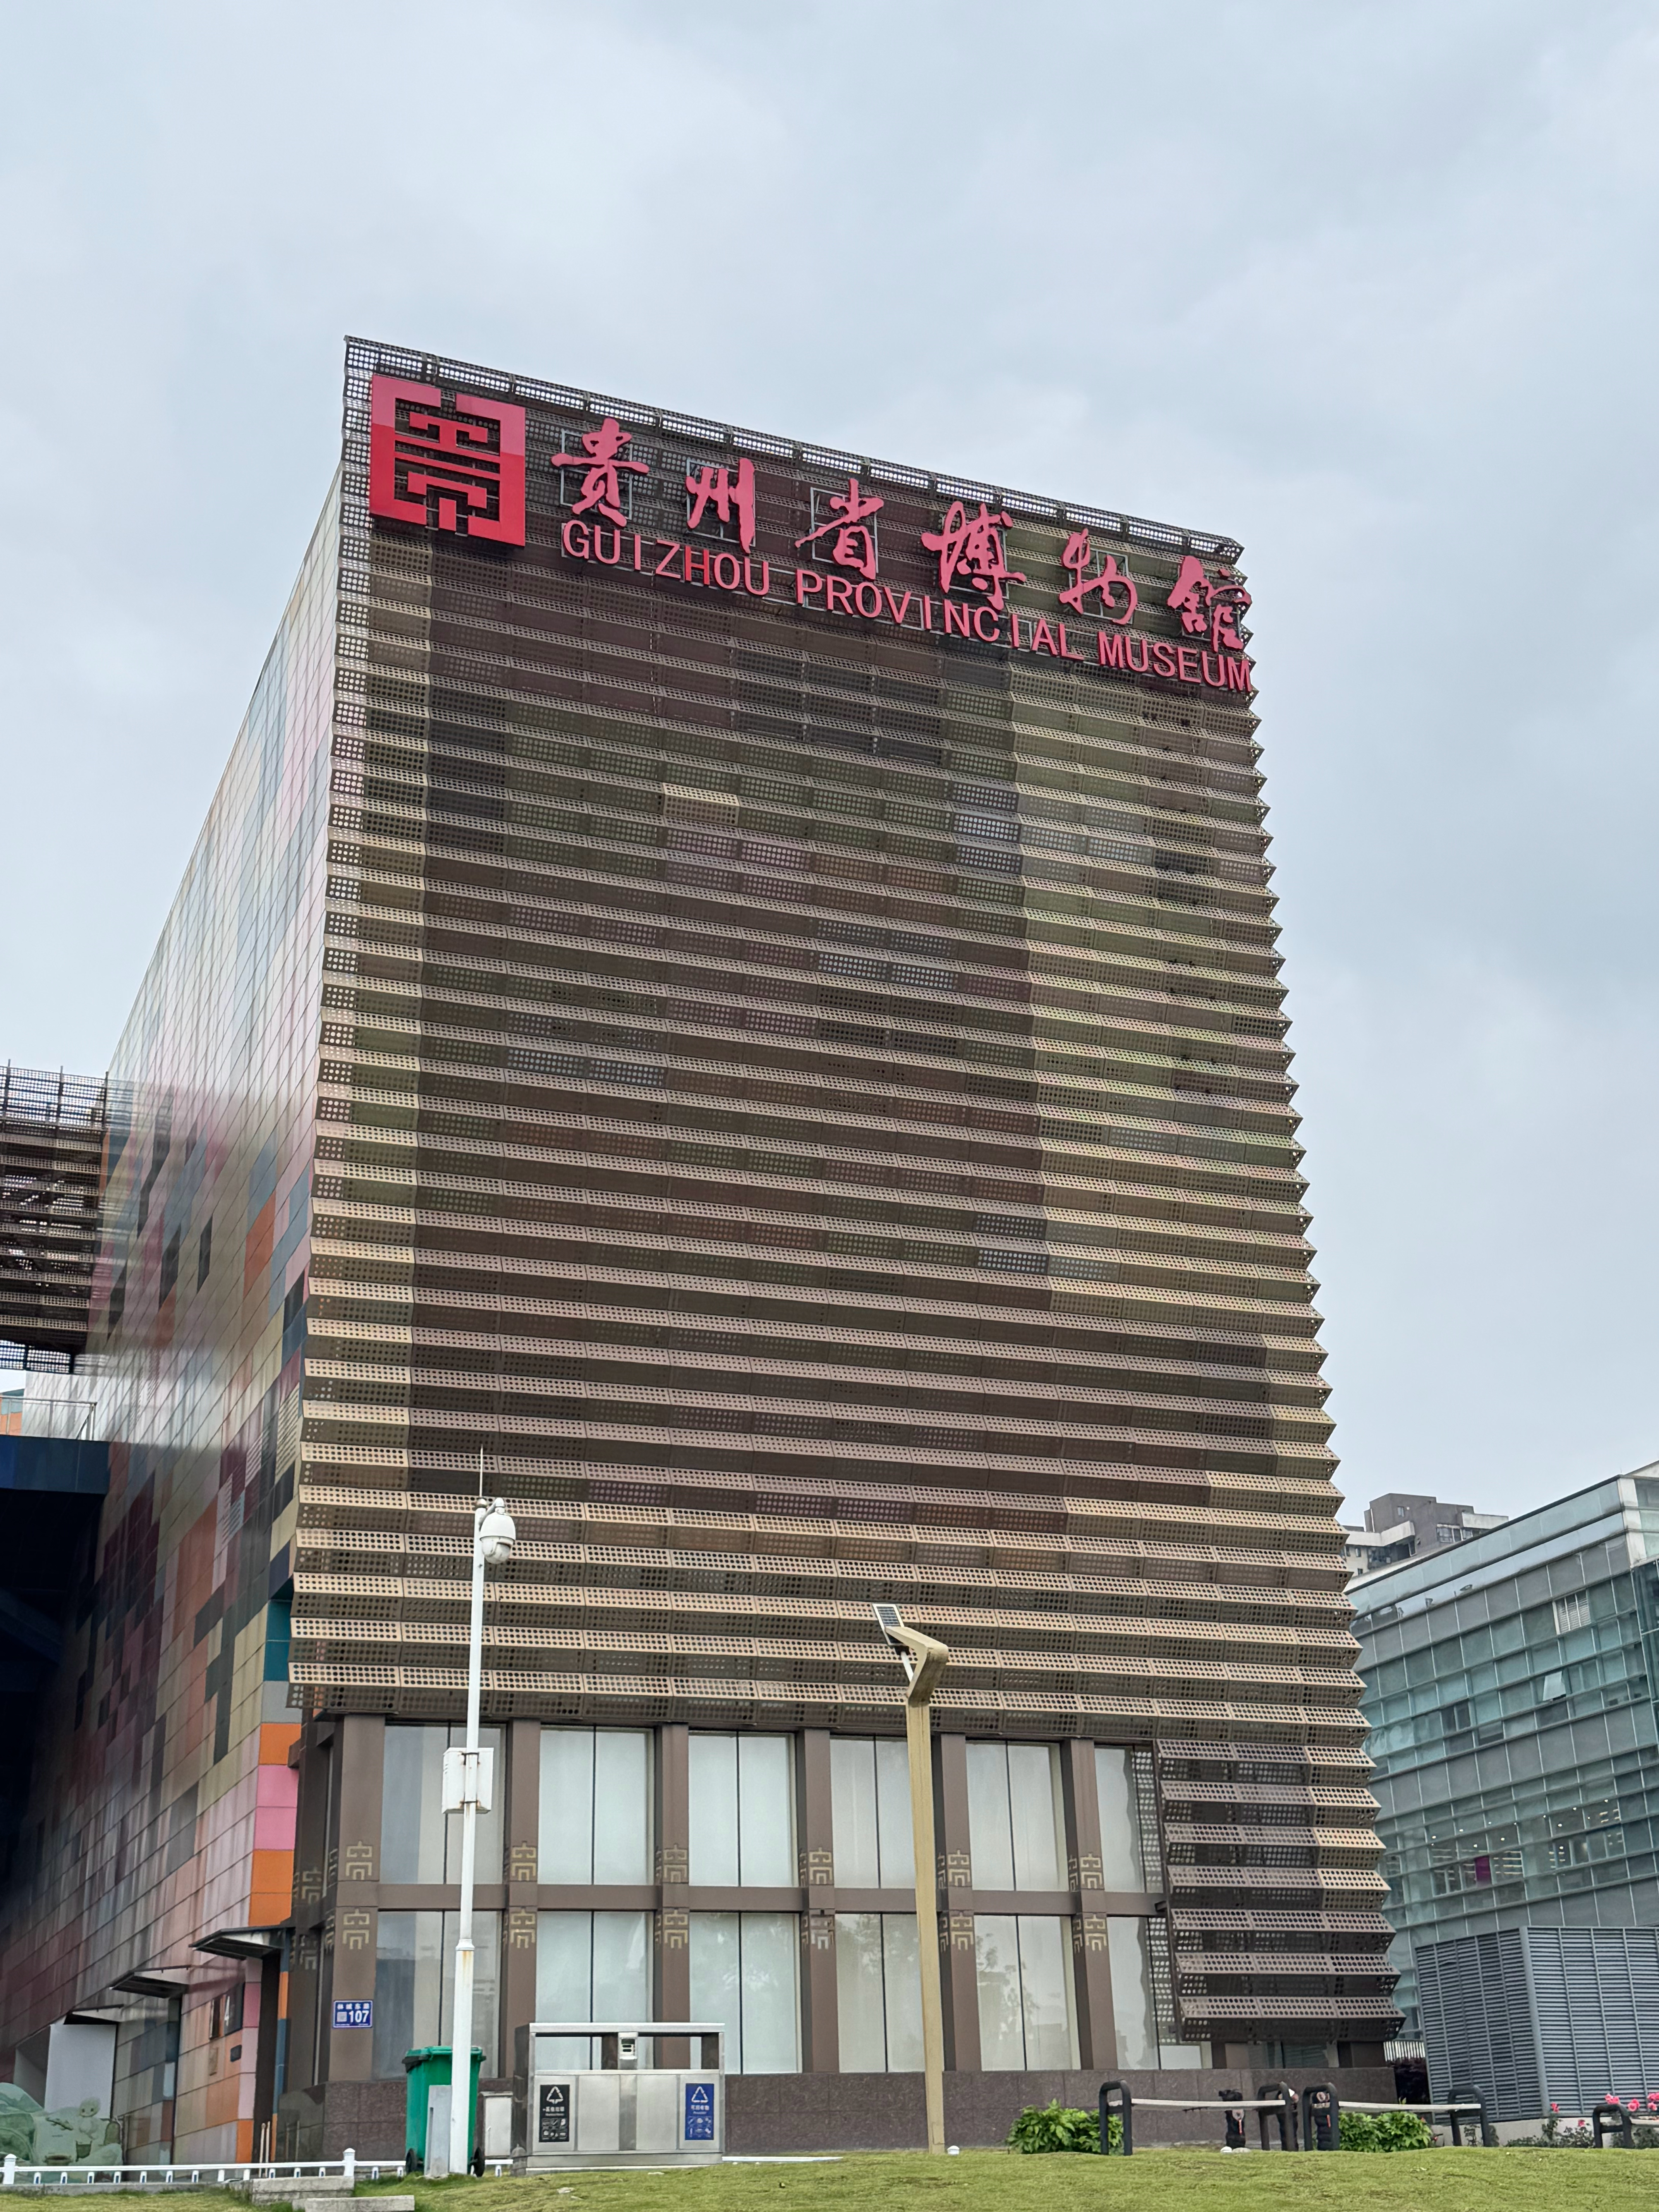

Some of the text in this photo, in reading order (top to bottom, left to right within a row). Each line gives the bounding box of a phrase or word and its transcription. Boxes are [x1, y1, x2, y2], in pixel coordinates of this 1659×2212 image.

[562, 520, 1253, 692] GUIZHOU PROVINCIAL MUSEUM
[349, 2010, 369, 2023] 107
